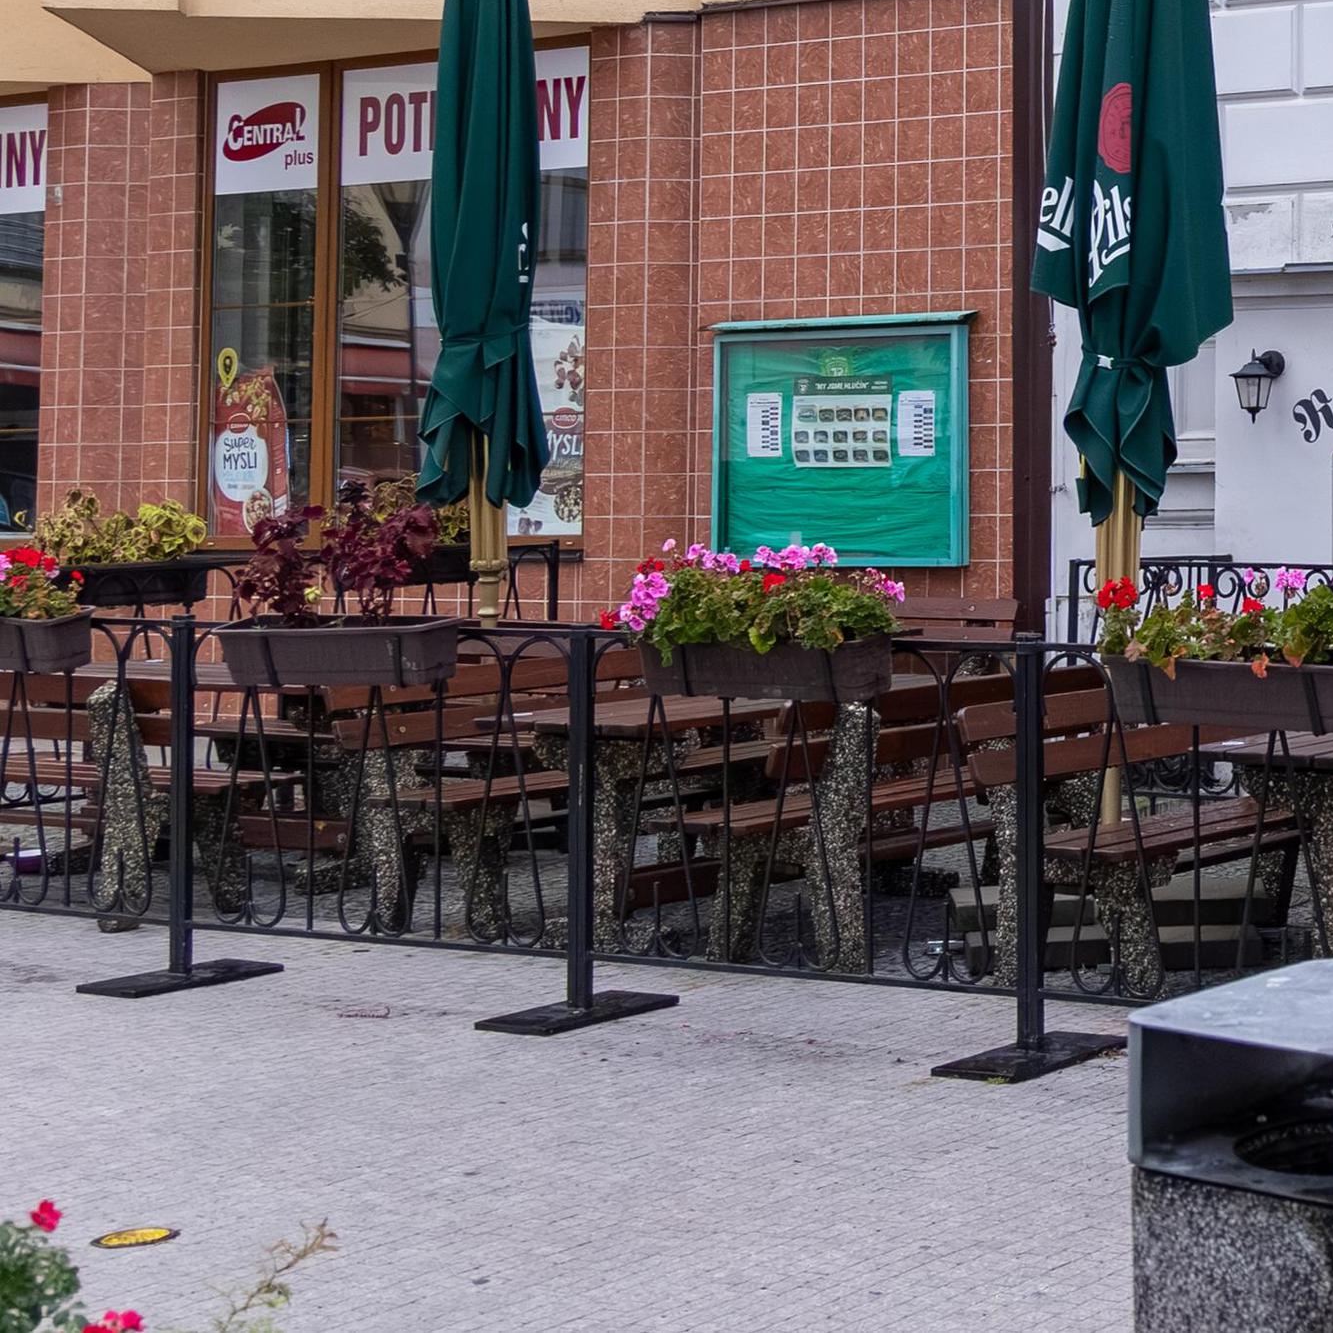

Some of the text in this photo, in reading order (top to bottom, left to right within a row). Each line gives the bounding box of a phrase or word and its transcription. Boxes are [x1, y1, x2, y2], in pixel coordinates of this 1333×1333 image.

[228, 107, 306, 151] CENTRAL
[284, 150, 314, 170] plus
[223, 451, 258, 471] MYSLI
